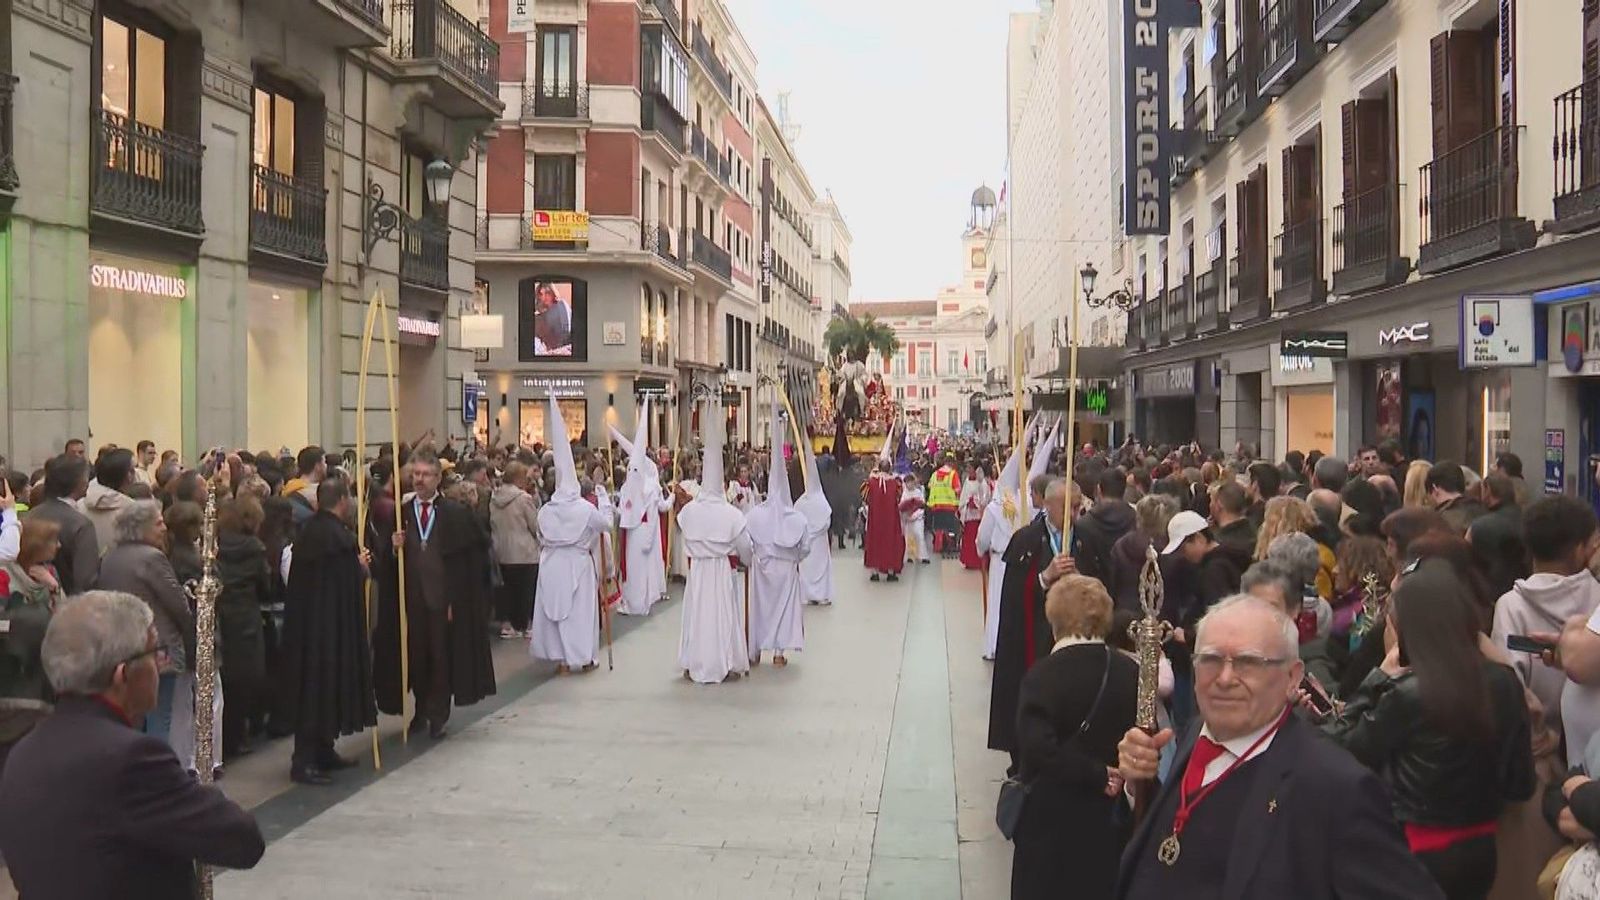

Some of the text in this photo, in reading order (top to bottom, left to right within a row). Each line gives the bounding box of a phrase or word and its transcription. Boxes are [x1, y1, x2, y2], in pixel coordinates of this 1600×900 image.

[1135, 66, 1160, 229] SPORT
[91, 264, 186, 298] STRADIVARIUS
[398, 316, 440, 337] STRADIVARIUS
[1379, 322, 1430, 346] MAC
[1285, 339, 1346, 349] MAC
